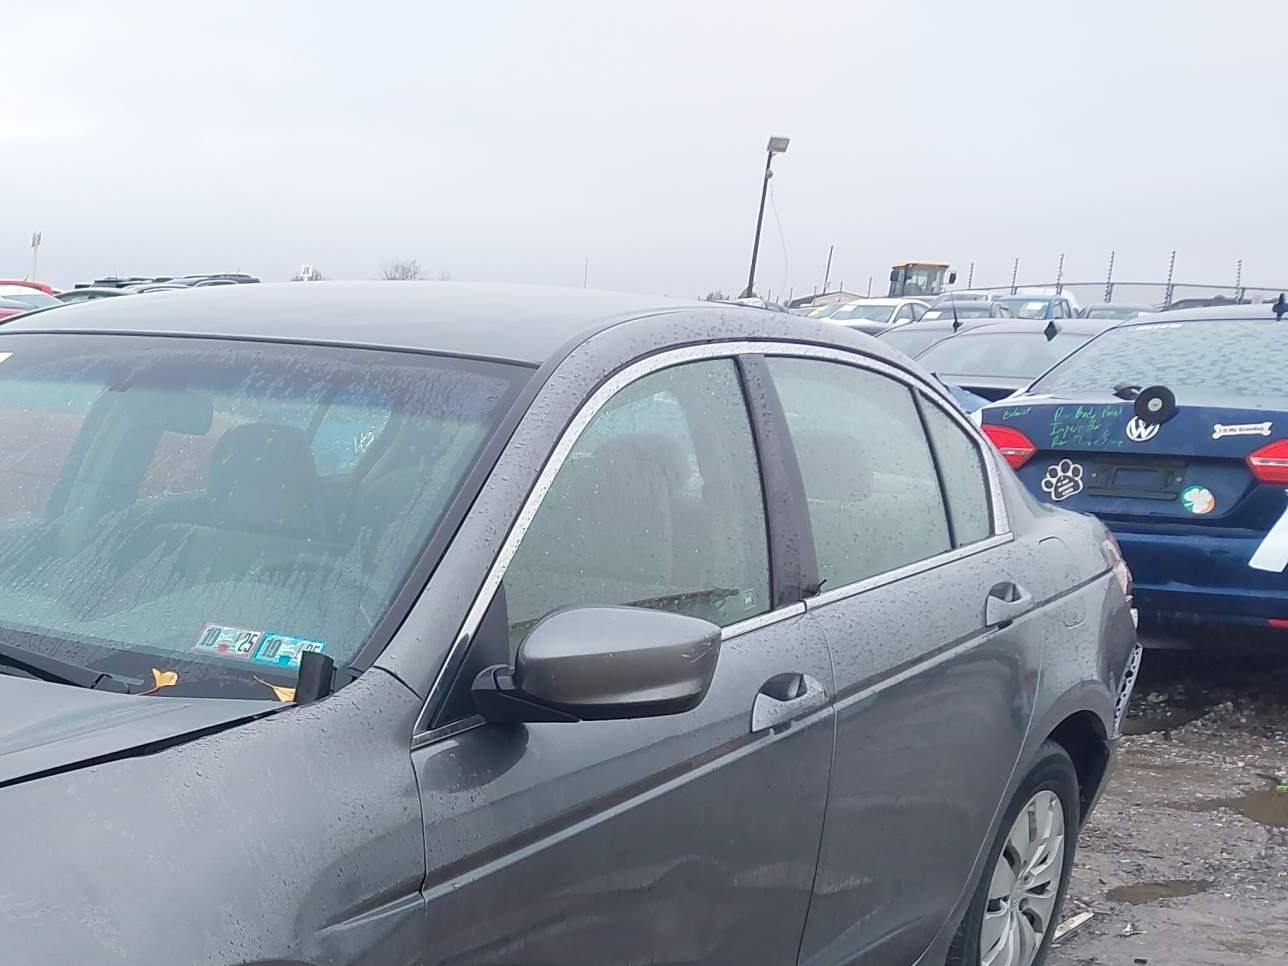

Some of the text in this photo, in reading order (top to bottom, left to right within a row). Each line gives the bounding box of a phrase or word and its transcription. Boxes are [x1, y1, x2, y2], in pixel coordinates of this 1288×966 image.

[200, 626, 258, 653] 10 25
[262, 637, 282, 658] 10
